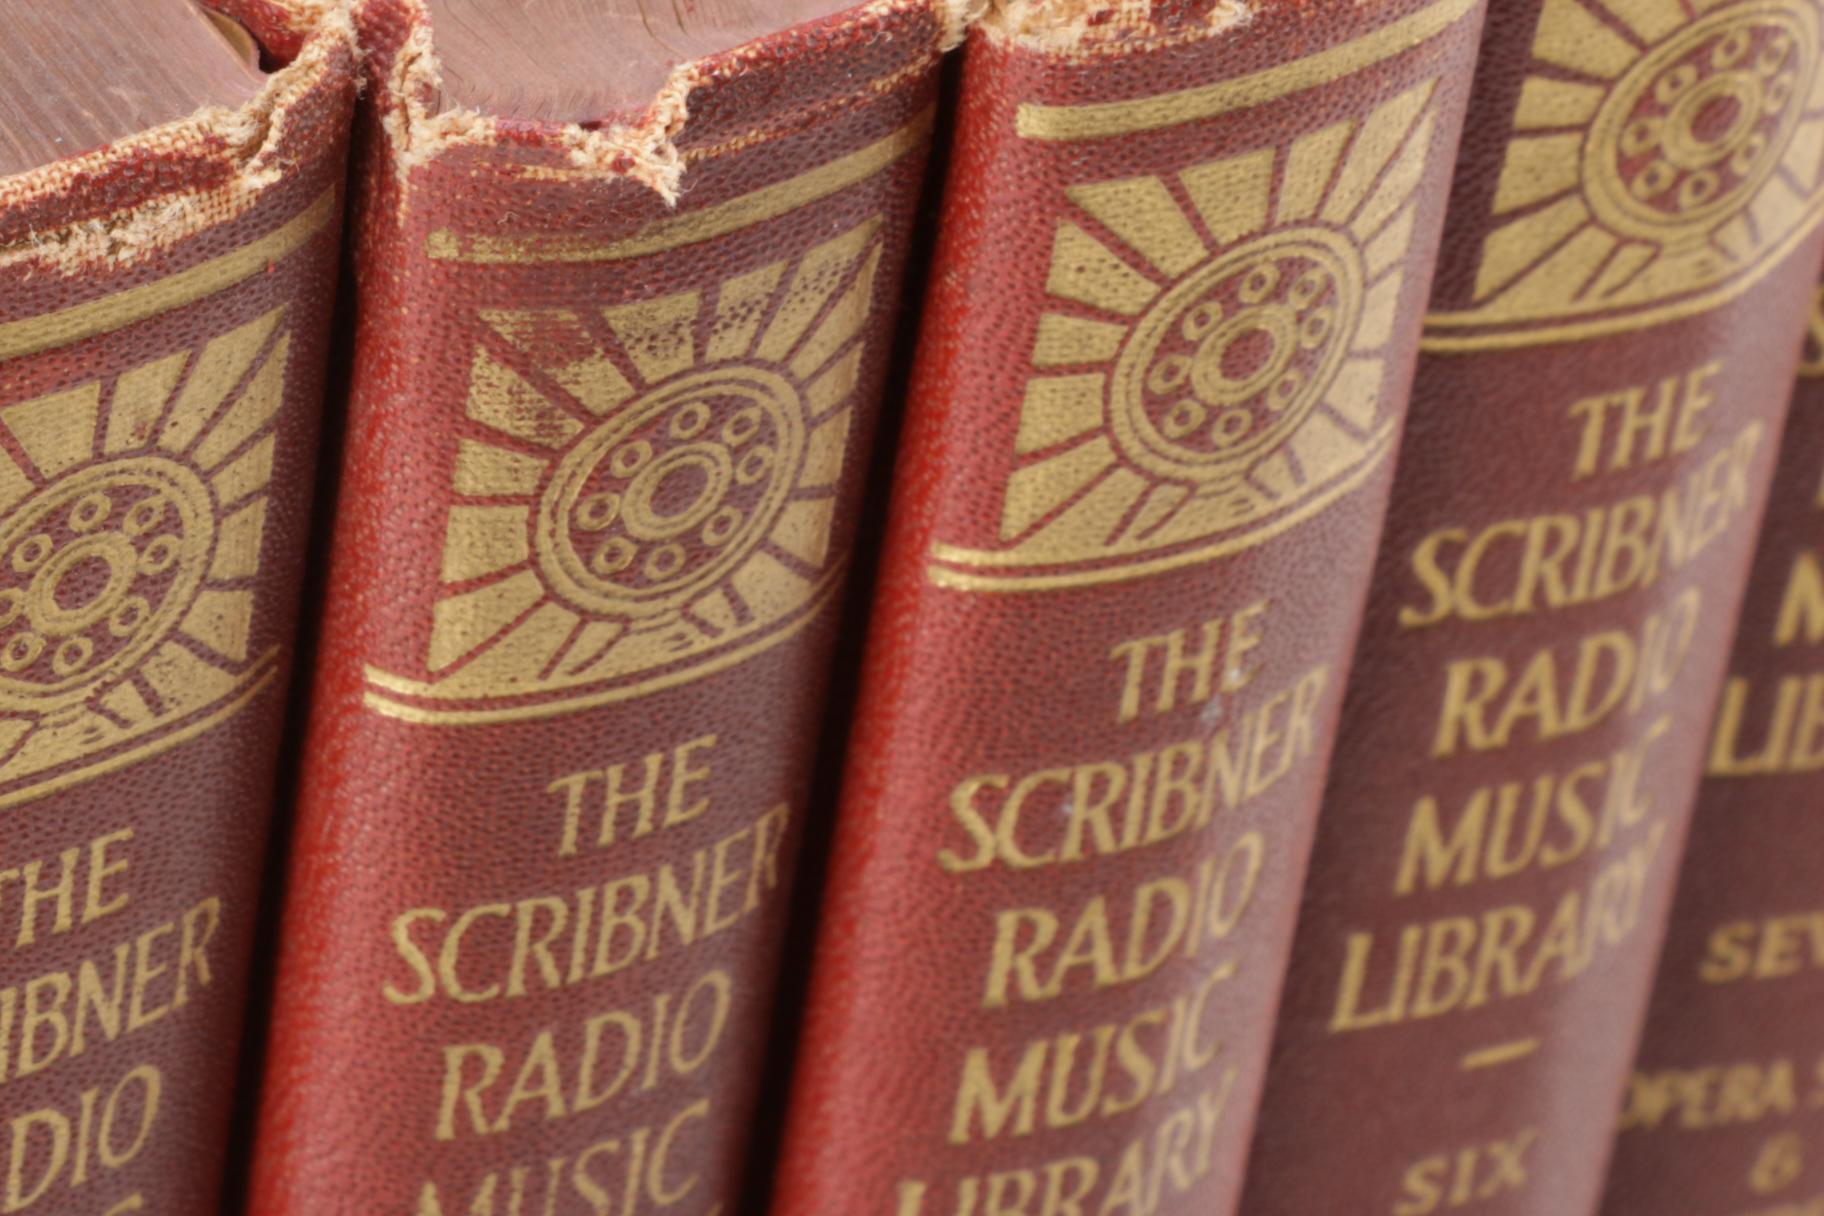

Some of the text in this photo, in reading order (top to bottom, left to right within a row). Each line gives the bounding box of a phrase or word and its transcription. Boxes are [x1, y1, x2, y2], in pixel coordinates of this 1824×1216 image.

[1570, 359, 1724, 481] THE
[1399, 419, 1764, 626] SCRIBNER
[1109, 598, 1270, 724] THE
[1431, 587, 1701, 758] RADIO
[547, 734, 718, 857] THE
[936, 663, 1330, 873] SCRIBNER
[1393, 715, 1671, 896] MUSIC
[382, 802, 789, 1005] SCRIBNER
[982, 832, 1266, 1009] RADIO
[1329, 819, 1667, 1034] LIBRARY
[434, 969, 732, 1141] RADIO
[947, 962, 1237, 1145] MUSIC
[1392, 1128, 1537, 1216] SIX
